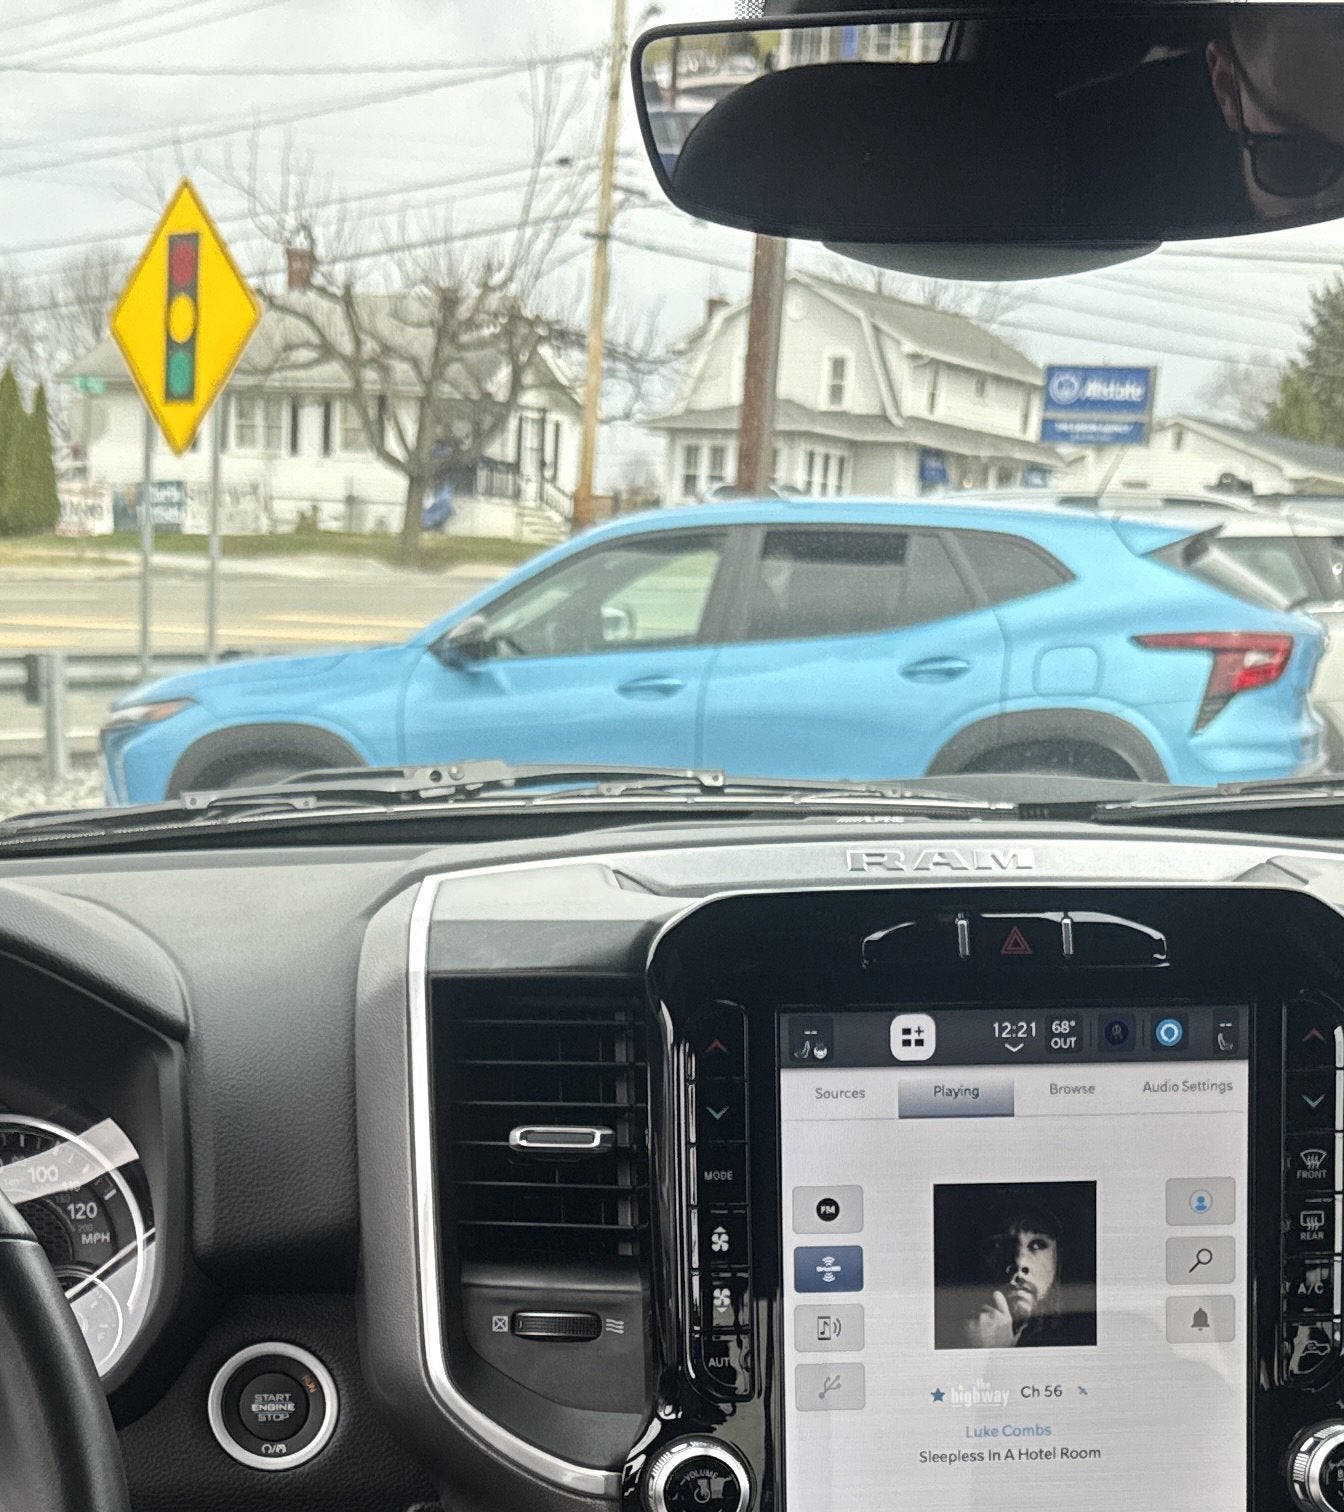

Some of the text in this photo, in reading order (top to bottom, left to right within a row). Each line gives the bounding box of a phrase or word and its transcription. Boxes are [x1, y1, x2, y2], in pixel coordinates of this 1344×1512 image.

[846, 848, 1035, 871] RAM
[993, 1020, 1036, 1038] 12:21
[1051, 1019, 1076, 1034] 68°
[1051, 1036, 1077, 1049] OUT
[815, 1087, 866, 1100] Sources
[933, 1085, 980, 1100] Playing
[1049, 1082, 1096, 1095] Browse
[1142, 1080, 1233, 1094] Audio Settings
[27, 1165, 59, 1183] 100
[703, 1170, 734, 1181] MODE
[1296, 1169, 1328, 1179] FRONT
[67, 1202, 98, 1220] 120
[820, 1205, 836, 1215] FM
[81, 1233, 111, 1245] MPH
[1300, 1230, 1324, 1240] REAR
[1297, 1281, 1325, 1294] A/C
[708, 1356, 738, 1368] AUTO
[255, 1393, 292, 1402] START
[951, 1384, 1010, 1407] highway
[1020, 1384, 1063, 1398] Ch 56
[251, 1402, 296, 1412] ENGINE
[257, 1413, 290, 1422] STOP
[966, 1423, 1052, 1438] Luke Combs
[919, 1446, 1101, 1465] Sleepless In A Hotel Room
[683, 1469, 719, 1482] VOLUME
